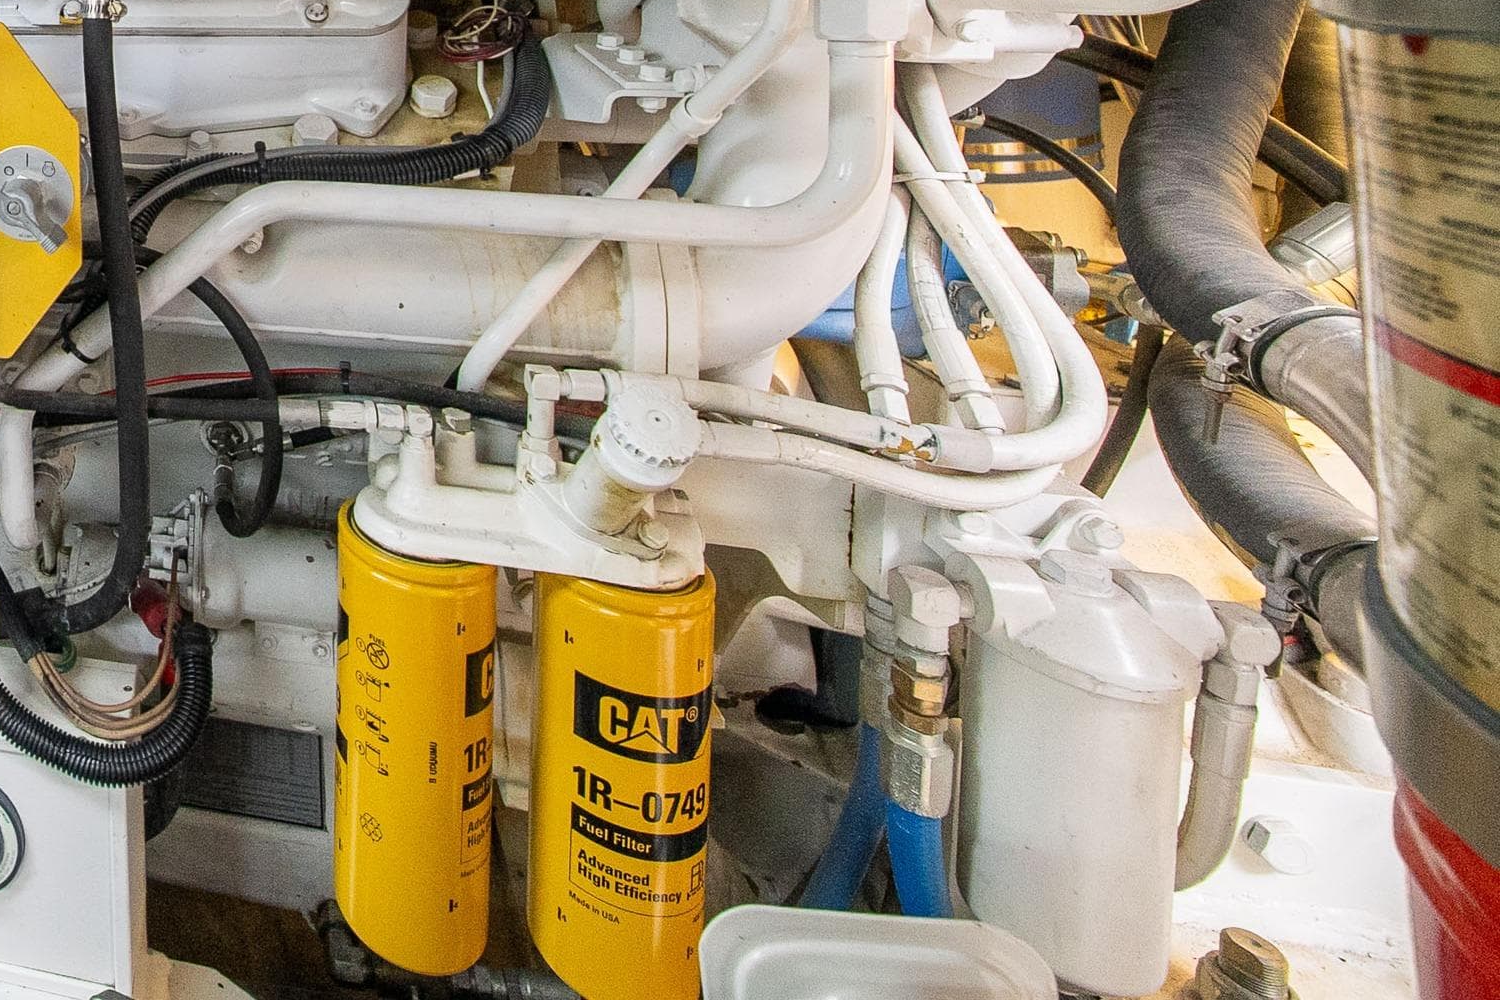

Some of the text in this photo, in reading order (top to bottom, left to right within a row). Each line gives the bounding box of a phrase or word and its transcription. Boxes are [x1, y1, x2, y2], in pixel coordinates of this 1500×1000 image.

[599, 696, 685, 754] CAT
[572, 766, 706, 824] 1R-0749
[578, 816, 652, 854] Fuel Filter
[578, 849, 650, 886] Advanced
[578, 863, 682, 904] High Efficiency
[568, 890, 590, 910] Made
[602, 910, 620, 924] USA
